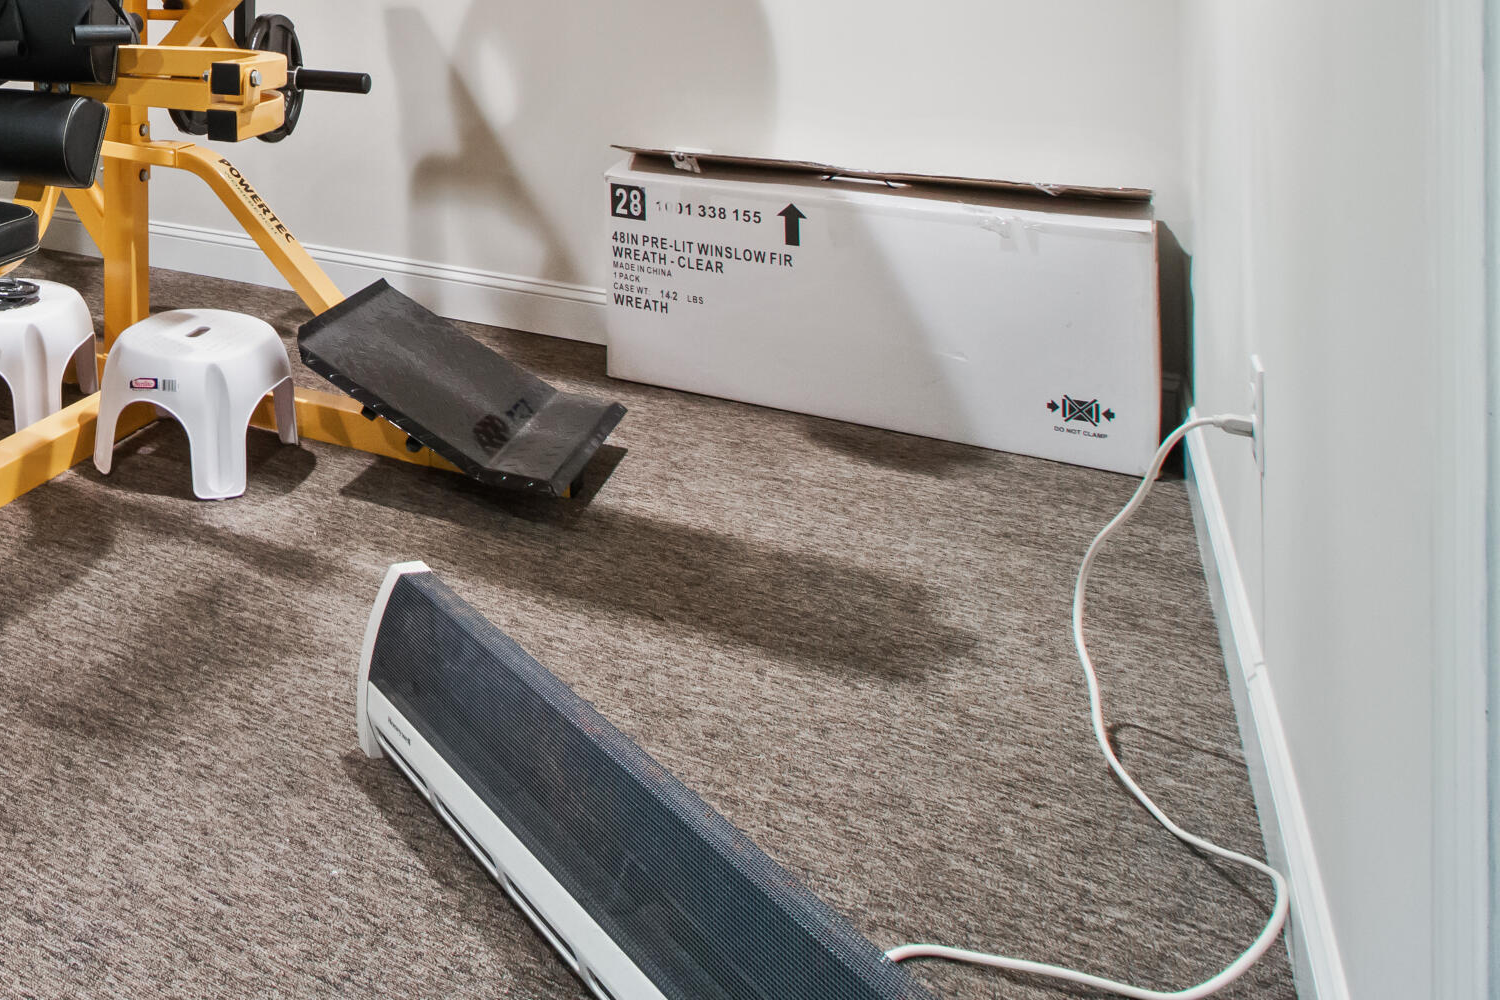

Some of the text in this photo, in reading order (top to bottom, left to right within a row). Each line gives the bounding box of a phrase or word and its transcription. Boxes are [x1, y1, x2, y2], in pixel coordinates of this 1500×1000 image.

[218, 158, 296, 244] POWERTEC
[615, 188, 642, 217] 28
[698, 205, 727, 220] 338
[733, 209, 762, 224] 155
[612, 231, 793, 267] 48IN PRE-LIT WINSLOW FIR
[613, 246, 667, 266] WREATH
[678, 256, 724, 274] CLEAR
[613, 261, 672, 278] MADE IN CHINA
[619, 273, 640, 283] PACK
[613, 282, 635, 293] CASE
[687, 295, 704, 305] LBS
[613, 293, 669, 314] WREATH
